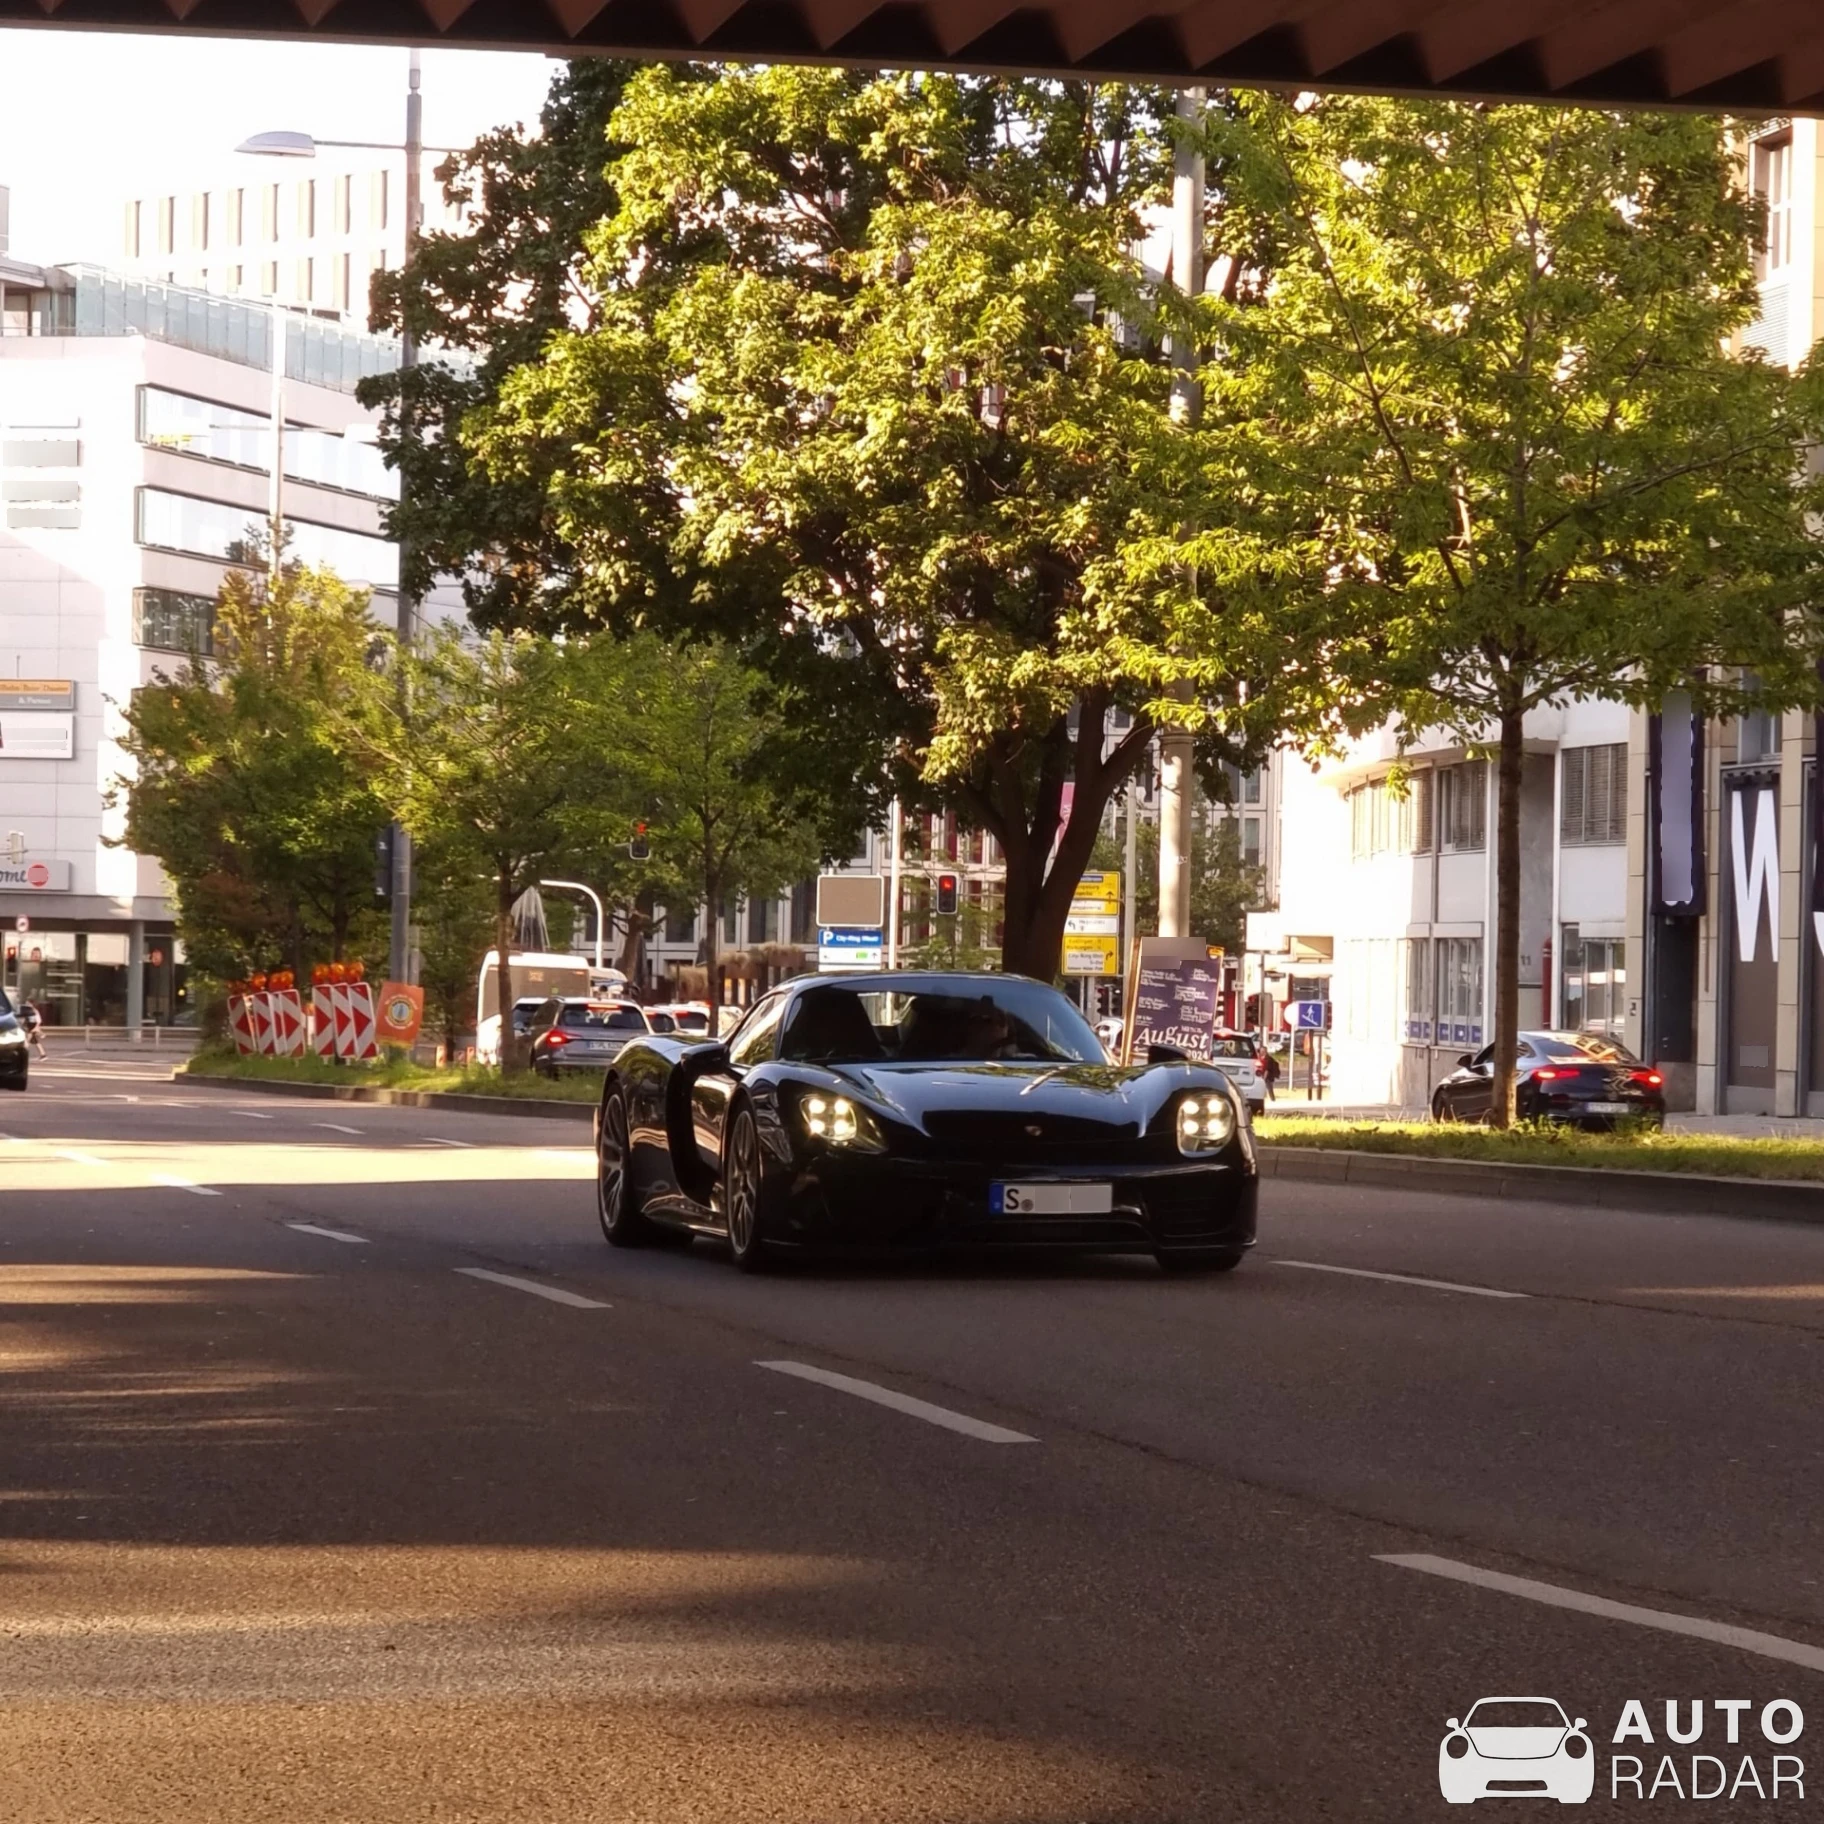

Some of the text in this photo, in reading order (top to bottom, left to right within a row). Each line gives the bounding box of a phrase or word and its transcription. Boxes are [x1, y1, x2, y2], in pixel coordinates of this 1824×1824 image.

[1133, 1025, 1210, 1050] August
[1186, 1048, 1210, 1061] 2024
[1005, 1188, 1019, 1210] S
